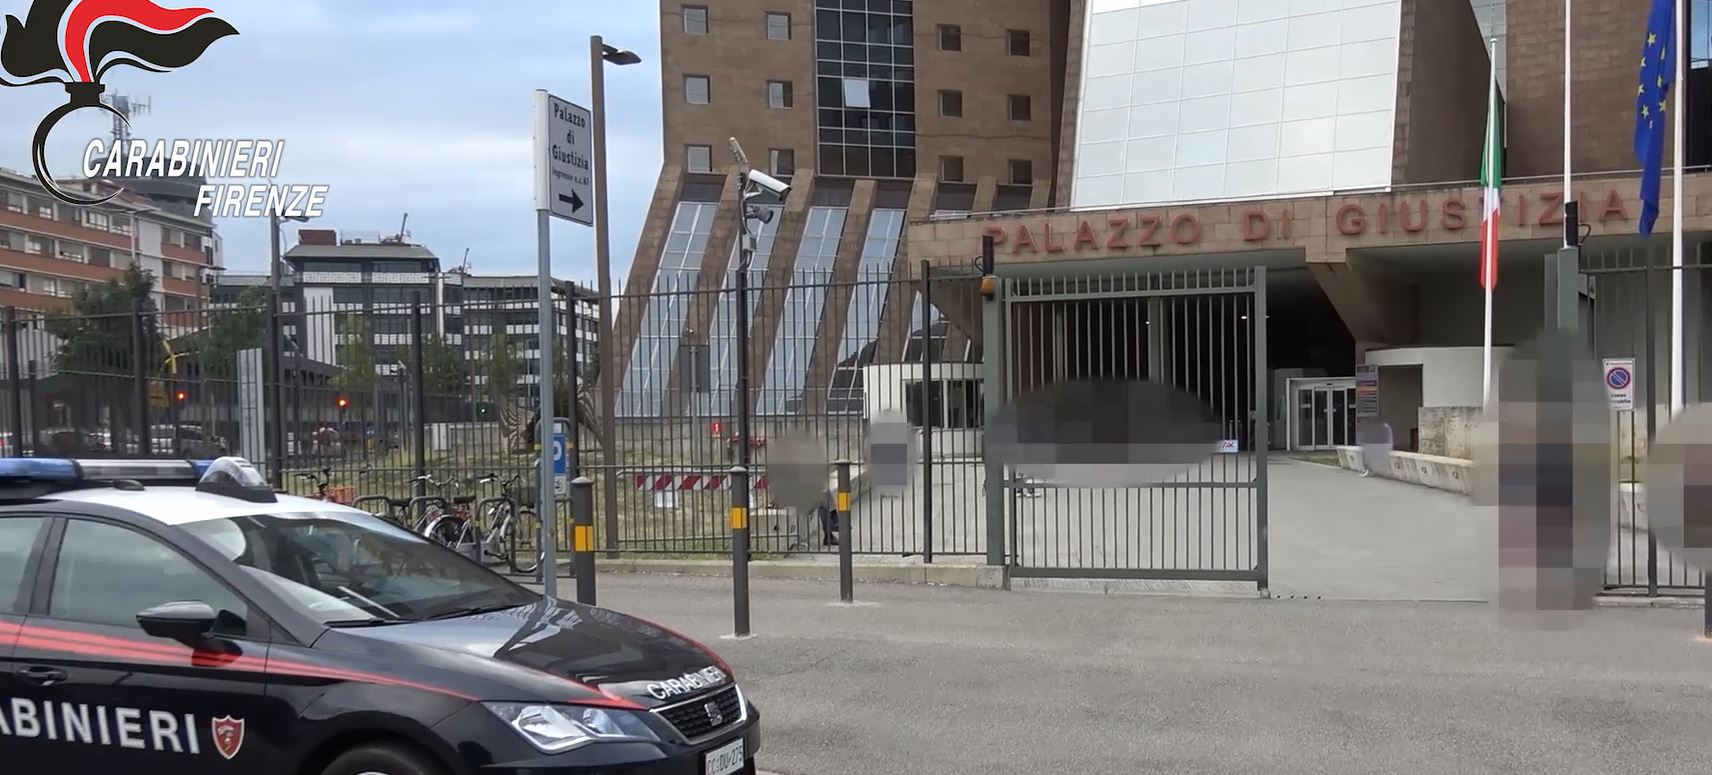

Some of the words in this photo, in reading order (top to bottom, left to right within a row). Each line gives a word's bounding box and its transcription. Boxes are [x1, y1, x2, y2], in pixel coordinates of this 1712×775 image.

[554, 102, 586, 128] Palazzo
[566, 129, 575, 145] di
[552, 144, 589, 170] Giustizia
[982, 212, 1200, 254] PALAZZO
[1242, 209, 1292, 242] DI
[1336, 188, 1629, 235] GIUSIZIA
